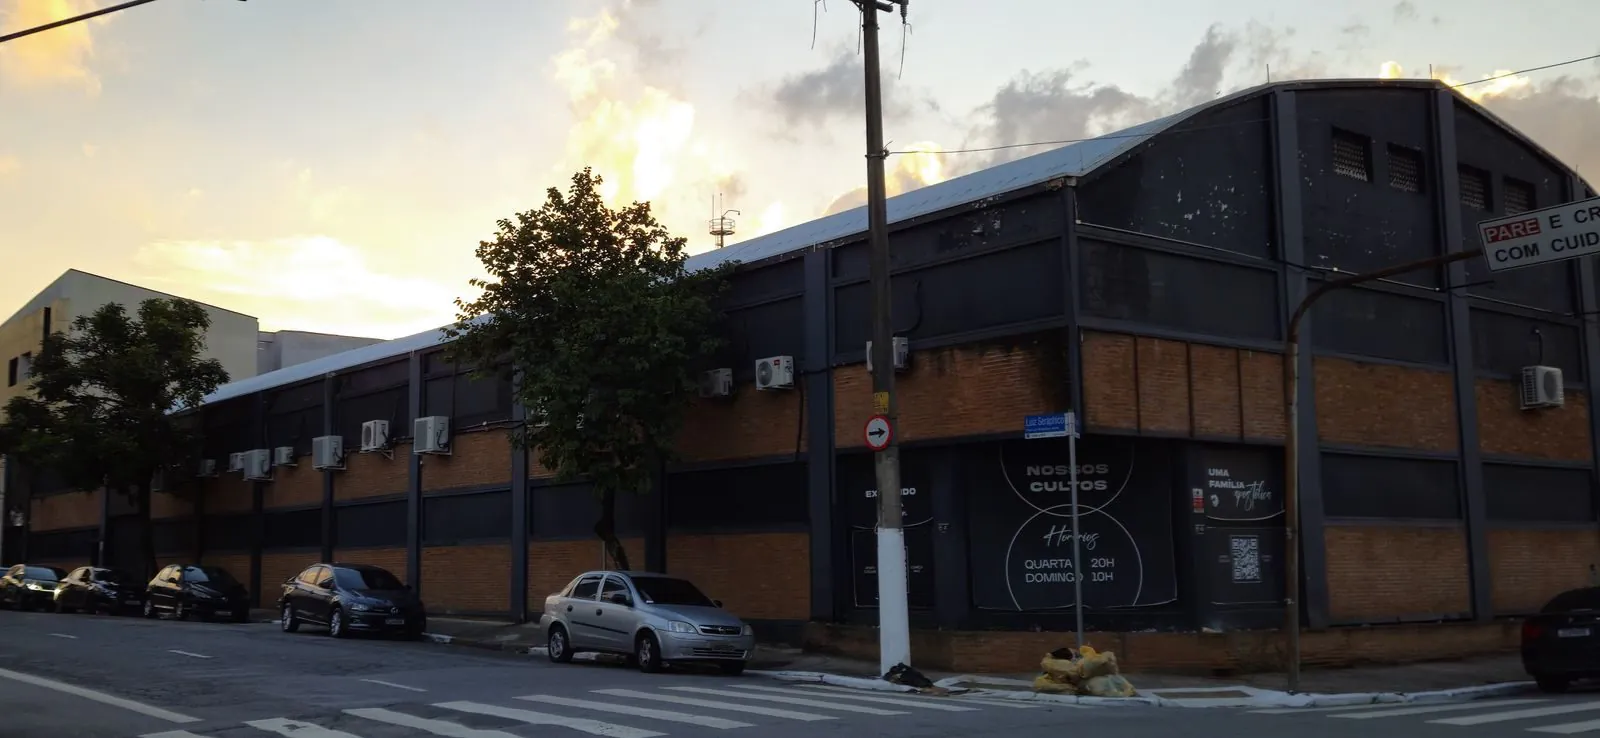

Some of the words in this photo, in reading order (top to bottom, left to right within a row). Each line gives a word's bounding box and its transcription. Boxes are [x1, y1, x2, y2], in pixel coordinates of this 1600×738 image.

[1485, 218, 1540, 242] PARE
[1549, 214, 1563, 229] E
[1495, 243, 1540, 262] COM
[1551, 231, 1600, 252] CUID
[1026, 463, 1109, 476] NOSSOS
[1208, 467, 1230, 477] UMA
[1029, 479, 1108, 492] CULTOS
[1208, 478, 1245, 489] FAMÍLIA
[1042, 524, 1100, 551] Horrios
[1024, 558, 1073, 570] QUARTA
[1090, 557, 1115, 568] 20H
[1091, 571, 1114, 582] 10H
